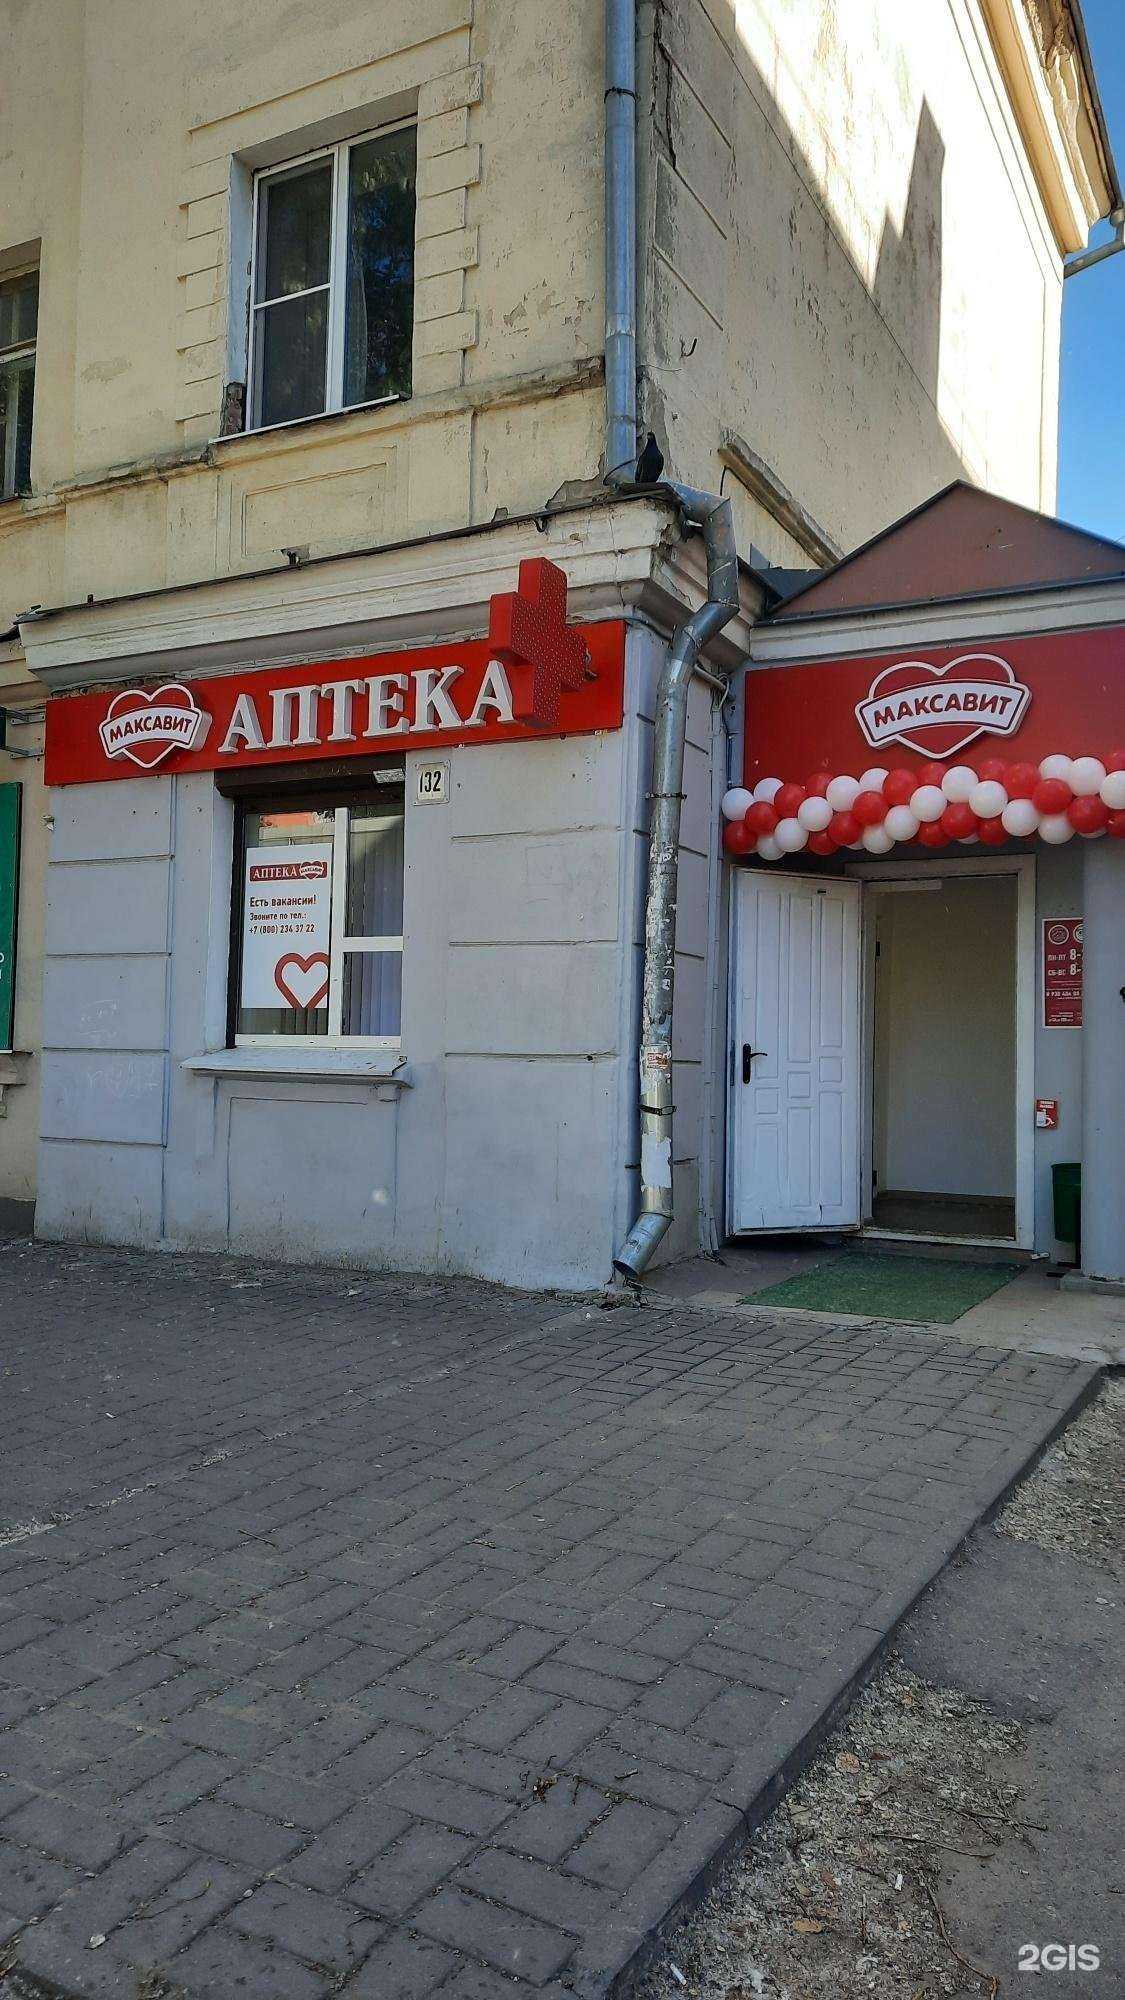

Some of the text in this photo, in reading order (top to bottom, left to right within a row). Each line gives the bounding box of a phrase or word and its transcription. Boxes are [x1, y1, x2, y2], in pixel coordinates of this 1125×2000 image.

[218, 660, 515, 753] АПТЕКА
[873, 692, 1013, 728] МАКСАВИТ
[109, 715, 193, 744] МАКСАВИТ
[419, 770, 442, 793] 132
[253, 867, 297, 878] АПТЕКА
[250, 895, 316, 907] Есть вакансии!
[249, 912, 278, 921] Звоните
[249, 926, 258, 934] +7
[259, 925, 278, 935] (800)
[295, 924, 304, 932] 37
[305, 924, 315, 932] 22
[1069, 948, 1083, 960] 8-
[1069, 963, 1083, 976] 8-
